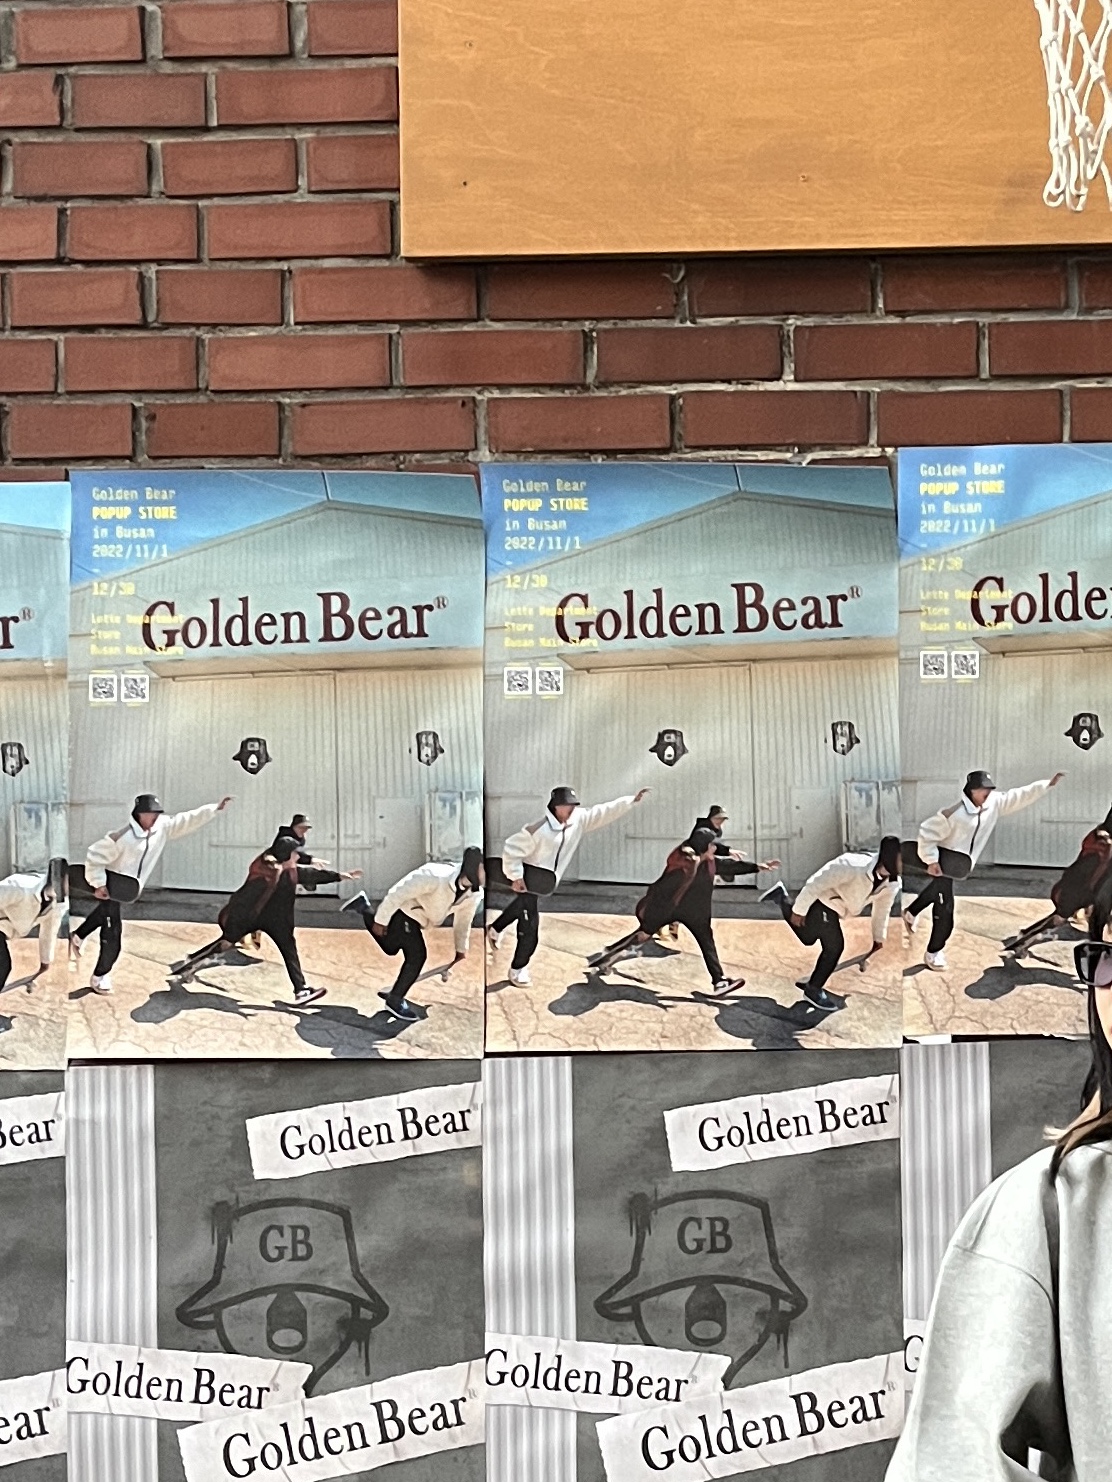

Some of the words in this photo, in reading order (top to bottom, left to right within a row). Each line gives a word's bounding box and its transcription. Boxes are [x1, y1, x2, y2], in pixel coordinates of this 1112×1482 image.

[920, 463, 967, 477] Golden
[974, 462, 1005, 476] Bear
[502, 478, 549, 493] Golden
[556, 478, 587, 492] Bear
[919, 481, 959, 496] POPUP
[966, 480, 1005, 495] STORE
[92, 487, 138, 501] Golden
[145, 487, 176, 500] Bear
[503, 498, 543, 512] POPUP
[550, 497, 589, 511] STORE
[921, 500, 936, 515] in
[943, 500, 982, 514] Busan
[92, 506, 132, 520] POPUP
[138, 506, 178, 520] STORE
[93, 525, 108, 539] in
[115, 525, 155, 539] Busan
[505, 518, 520, 531] in
[527, 517, 567, 531] Busan
[920, 518, 996, 535] 2022/11/1
[92, 544, 168, 560] 2022/11/1
[504, 536, 581, 552] 2022/11/1
[920, 556, 963, 572] 12/30
[92, 581, 135, 598] 12/30
[504, 574, 548, 590] 12/30
[555, 588, 724, 644] Golden
[142, 599, 309, 652] Golden
[280, 1117, 394, 1160] Golden
[698, 1109, 812, 1152] Golden
[259, 1225, 315, 1263] GB
[677, 1217, 733, 1255] GB
[66, 1356, 183, 1403] Golden
[485, 1349, 602, 1396] Golden
[222, 1417, 371, 1479] Golden
[641, 1409, 790, 1471] Golden
